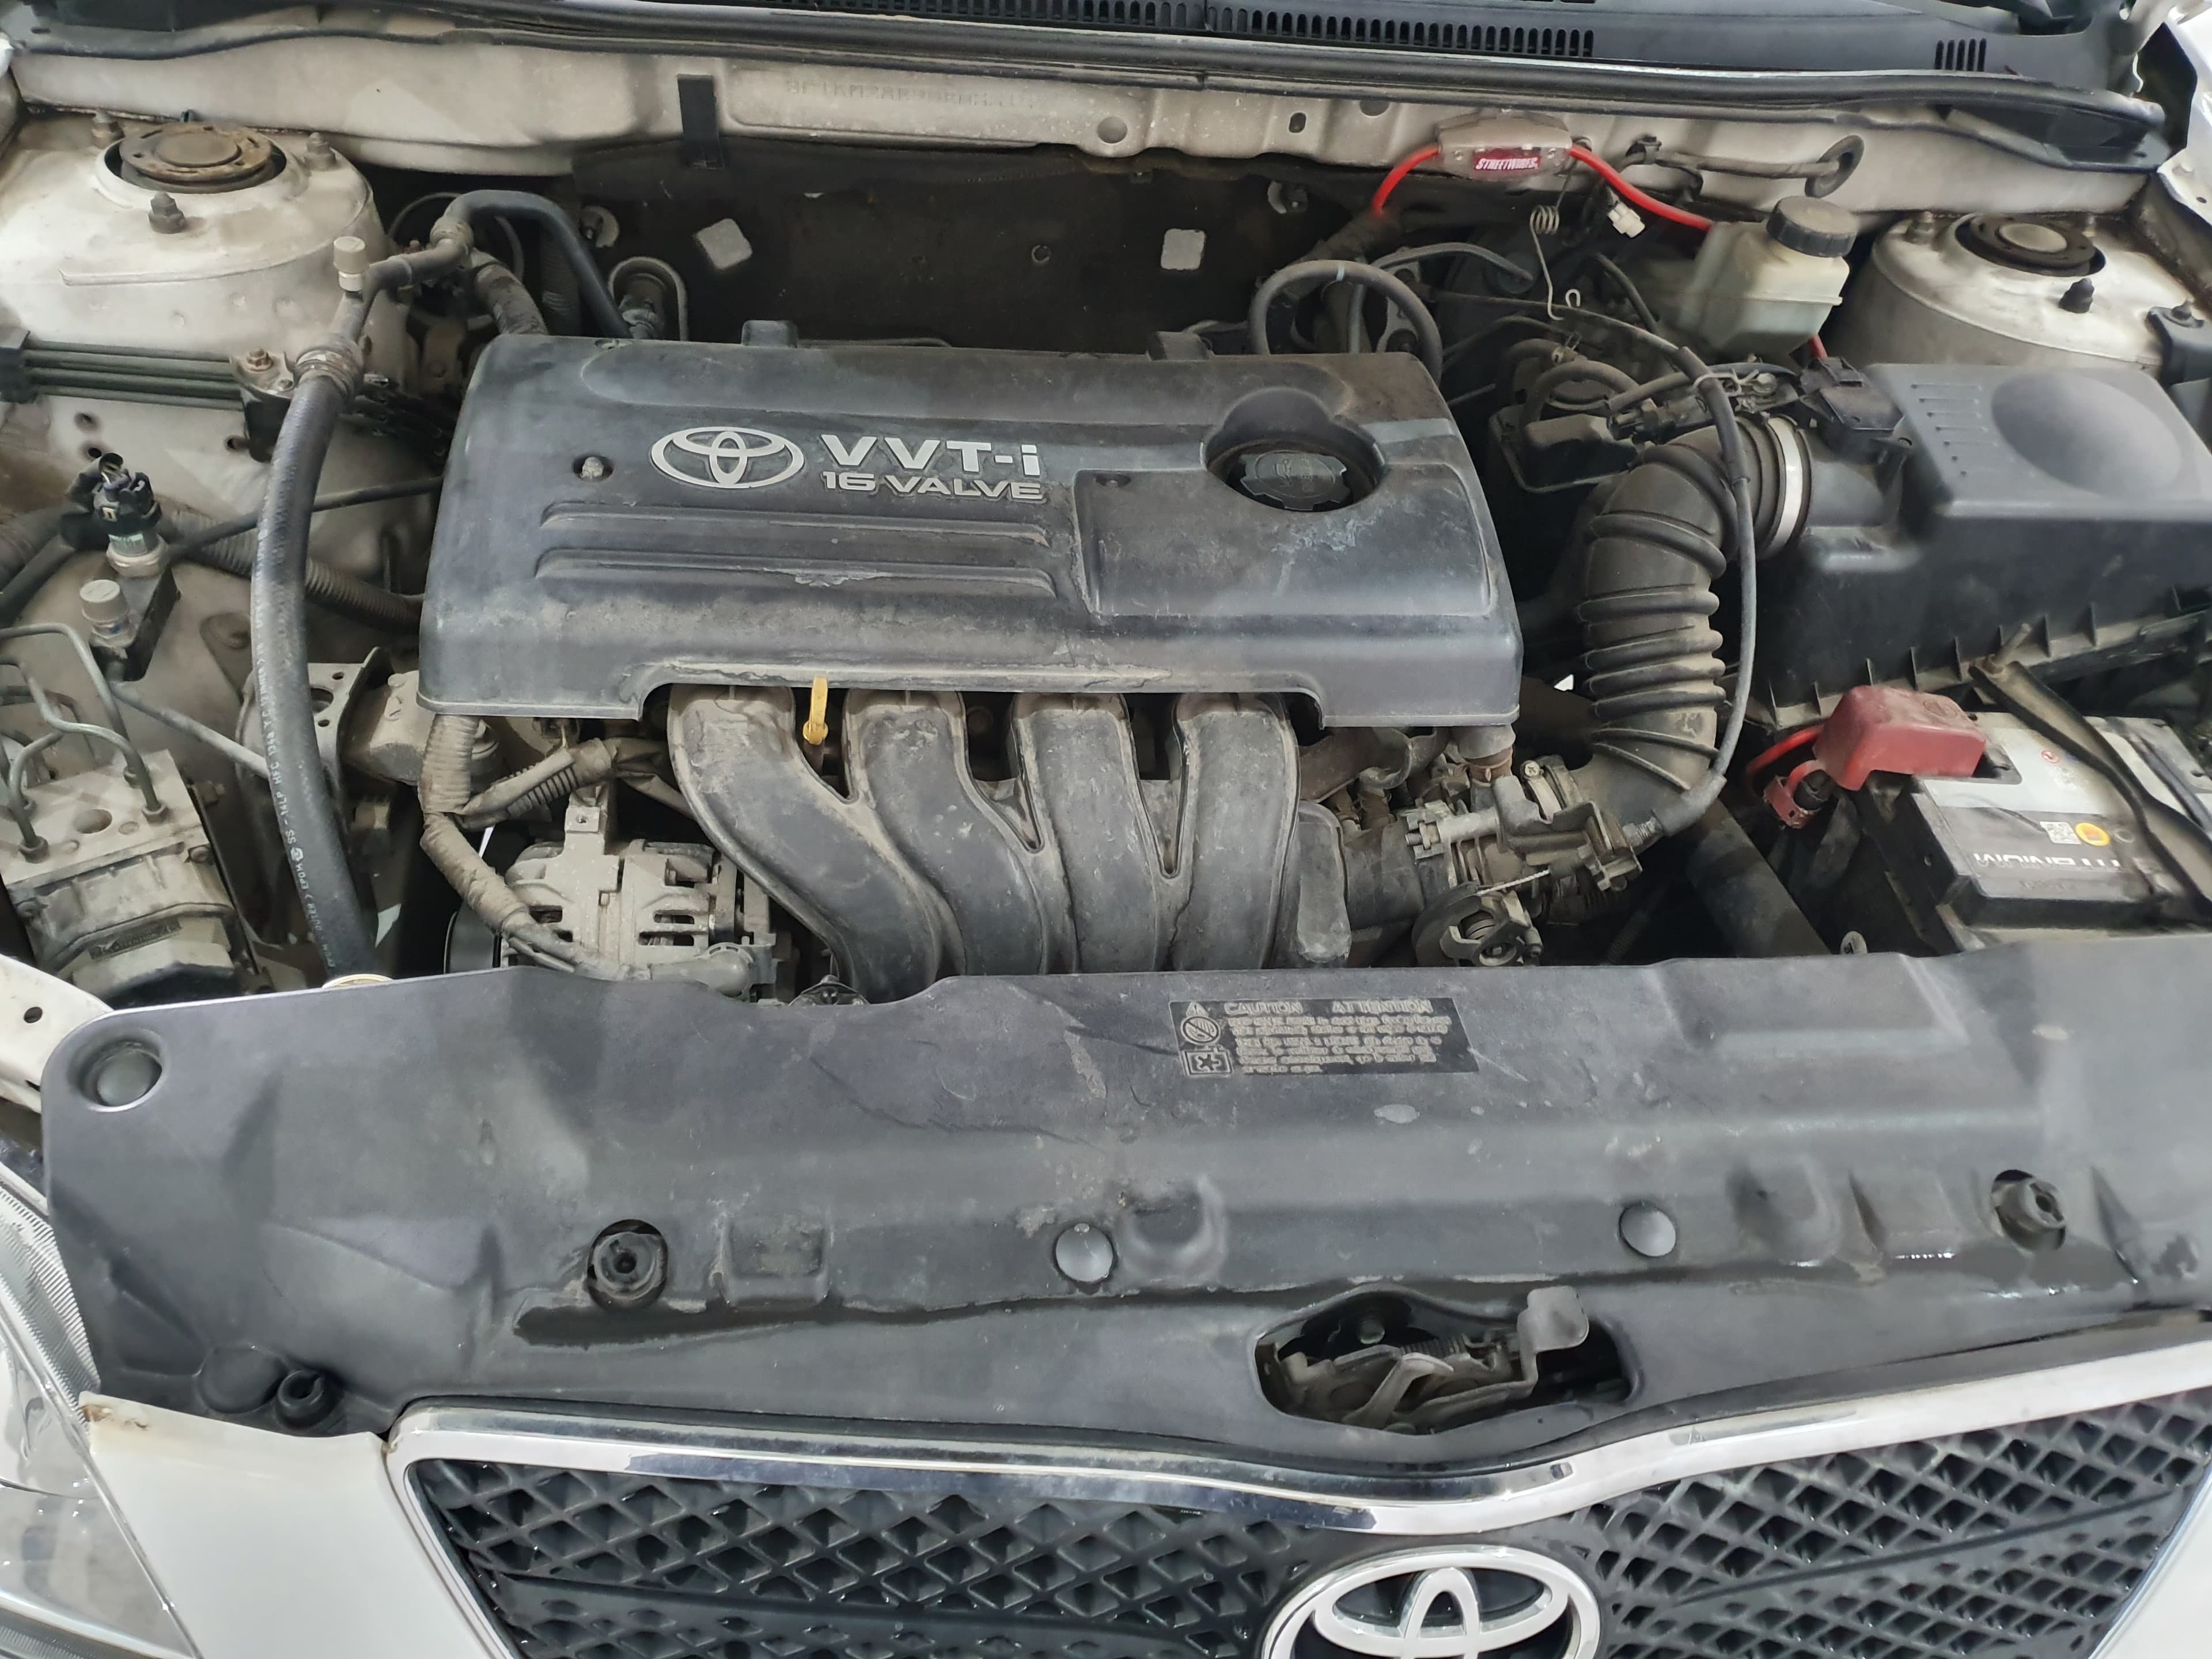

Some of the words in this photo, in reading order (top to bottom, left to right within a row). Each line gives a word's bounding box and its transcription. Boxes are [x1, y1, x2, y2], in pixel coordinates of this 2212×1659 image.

[820, 434, 1041, 476] VVT-i
[823, 471, 877, 491] 16
[885, 475, 1044, 500] VALVE
[271, 761, 282, 784] HFC
[1224, 1001, 1304, 1016] CAUTION
[1332, 998, 1434, 1014] ATTENTION
